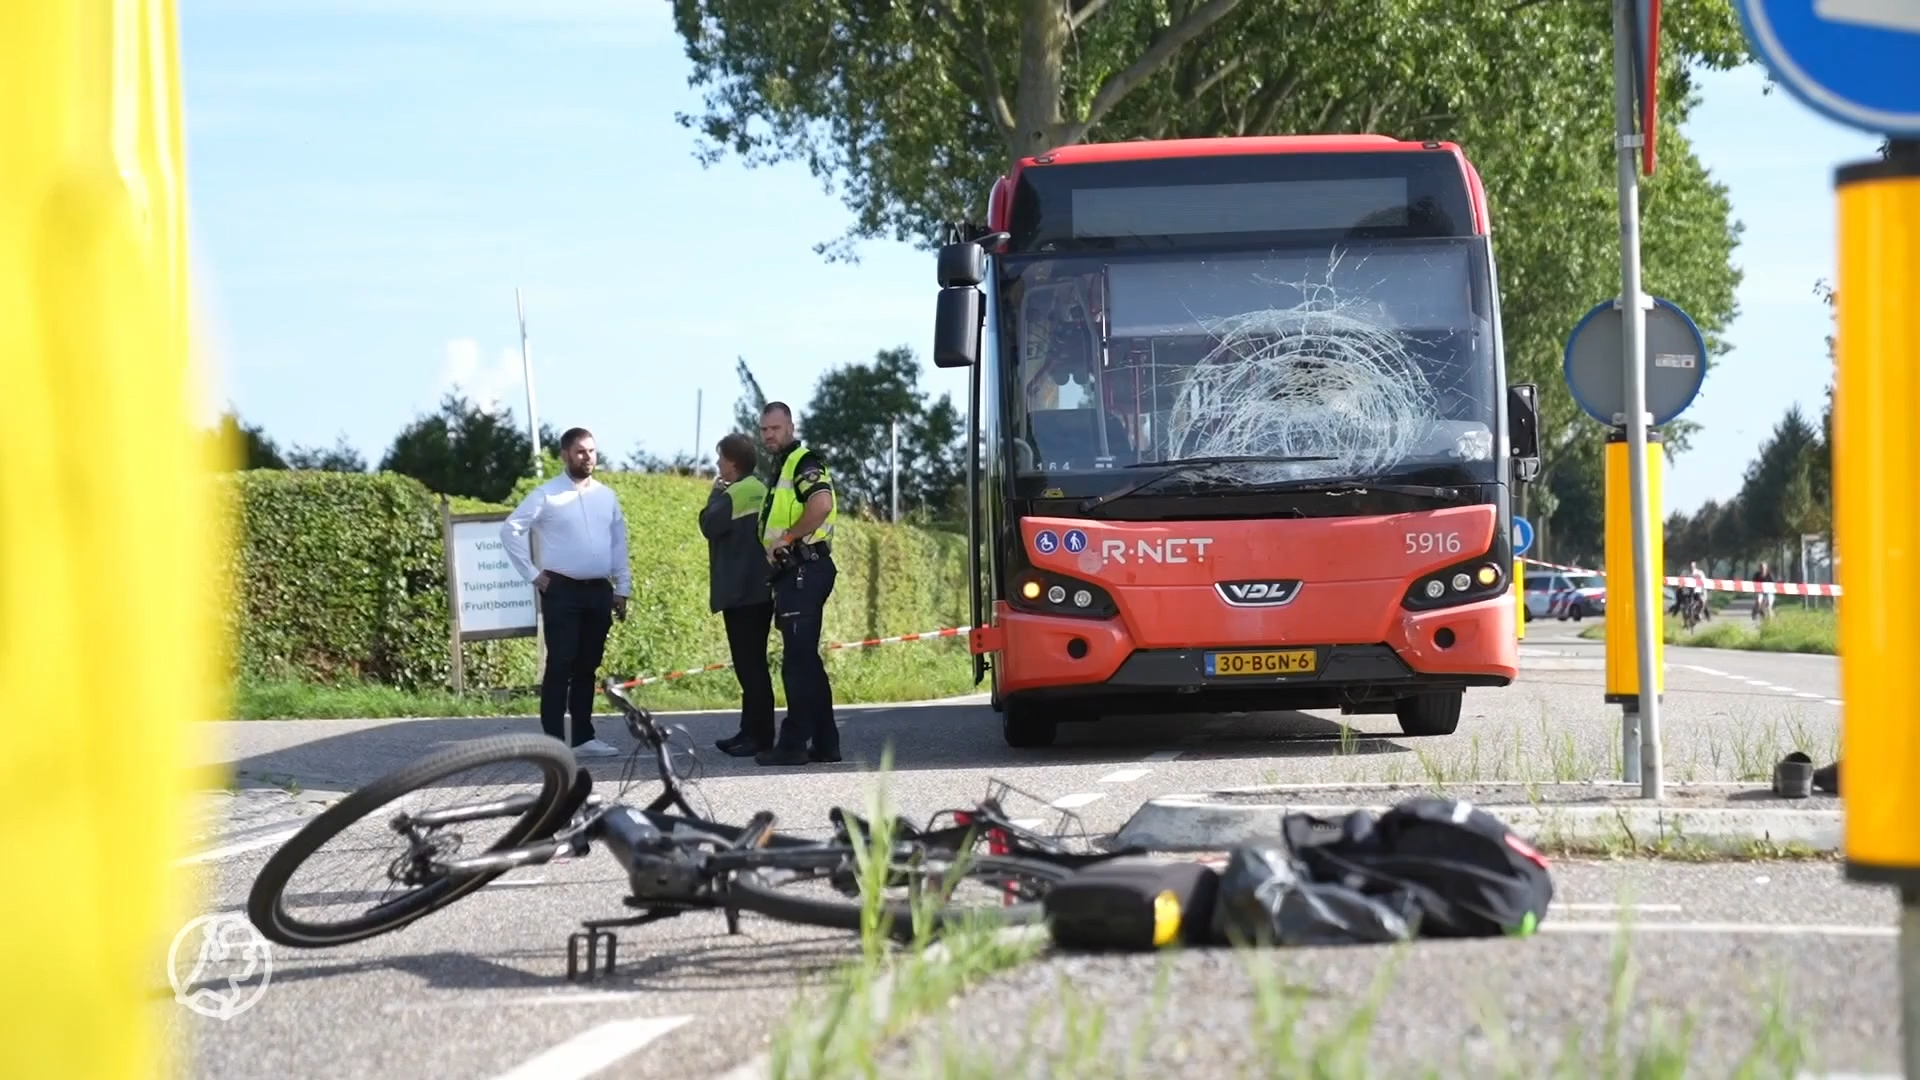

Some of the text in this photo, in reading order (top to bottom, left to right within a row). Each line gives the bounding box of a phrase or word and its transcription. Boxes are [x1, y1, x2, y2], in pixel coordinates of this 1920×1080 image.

[1405, 532, 1461, 554] 5916
[478, 560, 510, 571] Heide
[1229, 583, 1286, 599] VDL
[460, 599, 532, 613] (Fruit)bomen
[1219, 653, 1310, 672] 30-BGN-6
